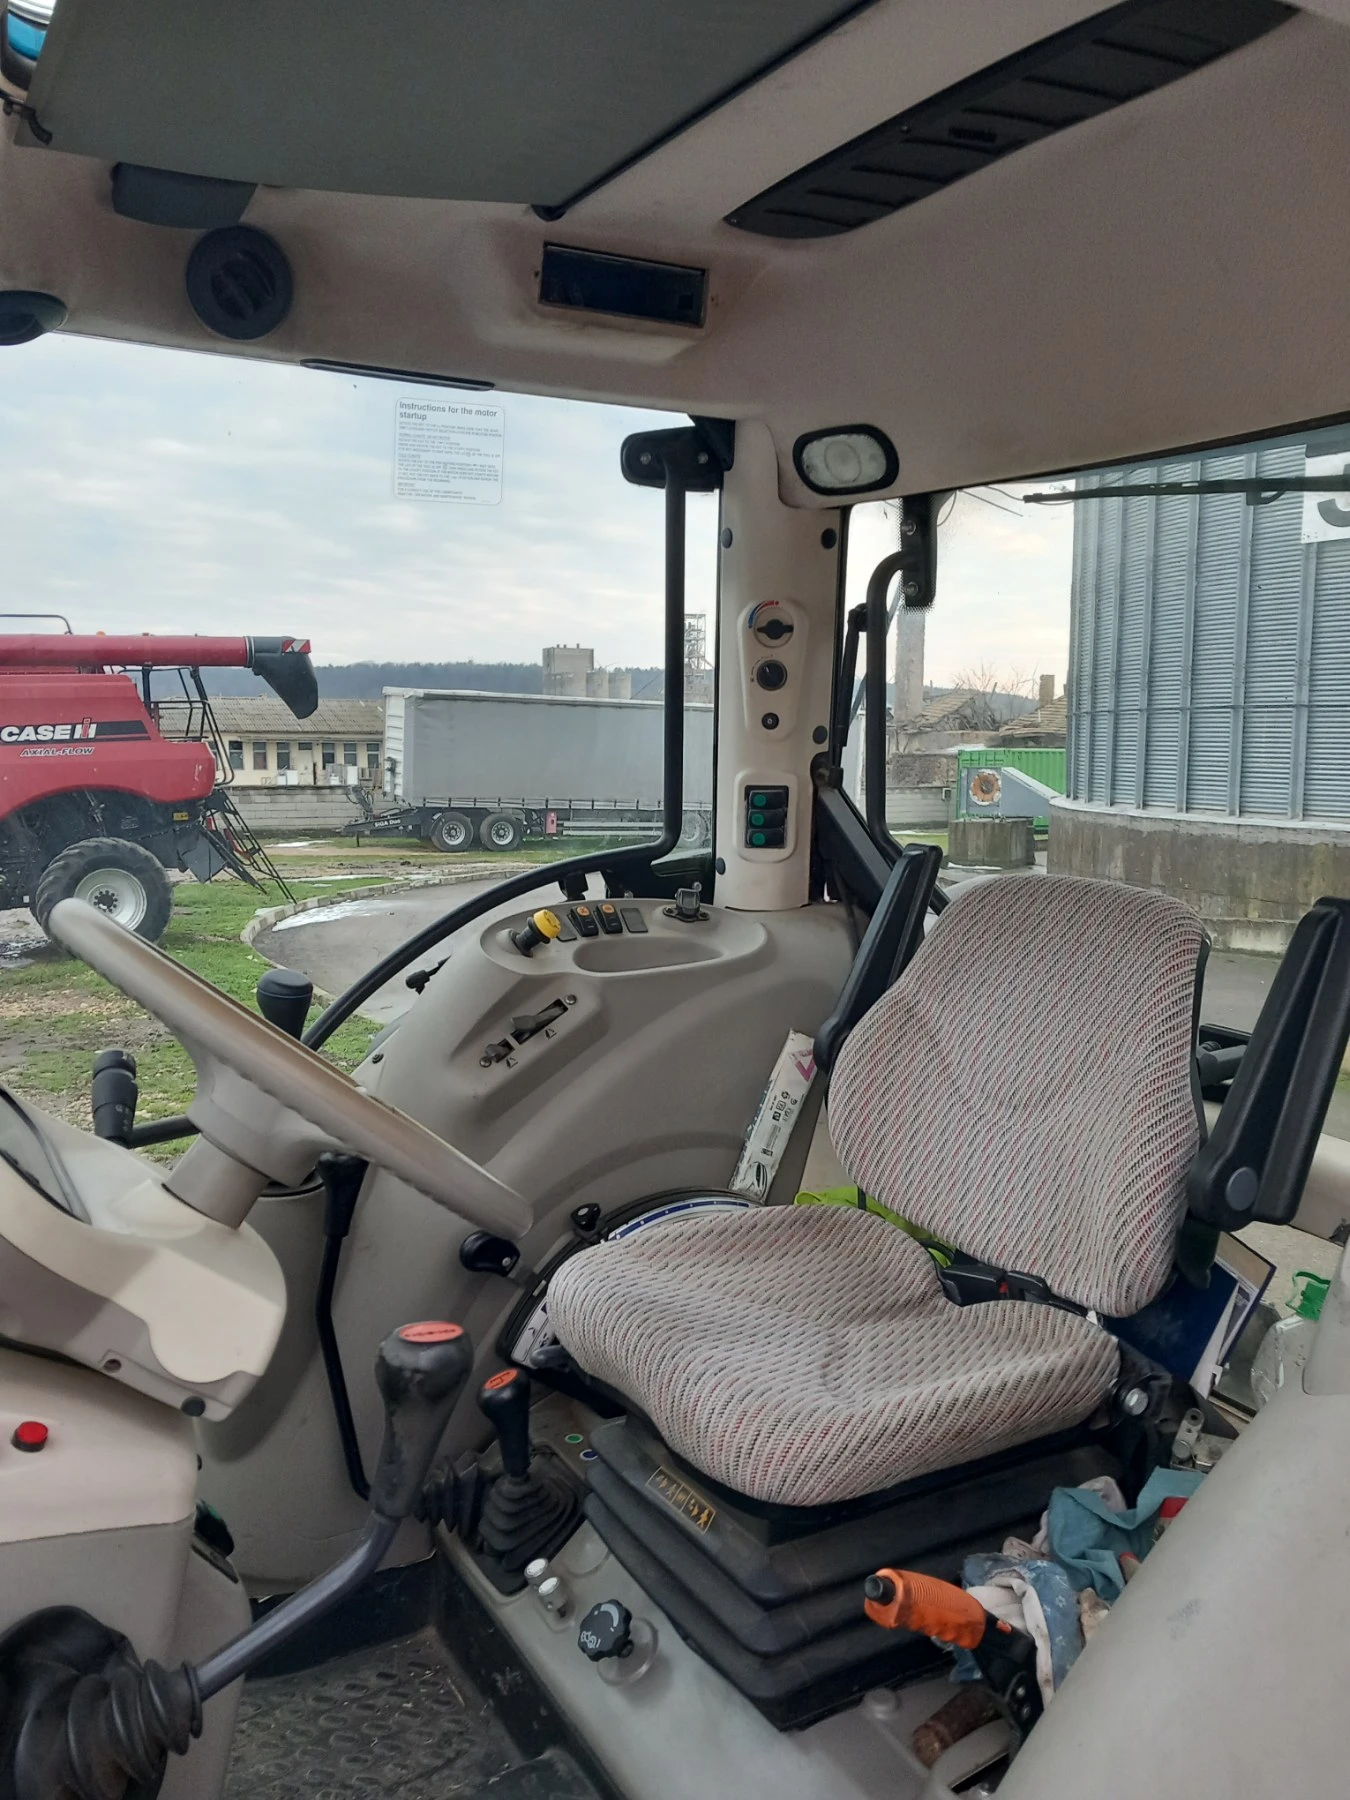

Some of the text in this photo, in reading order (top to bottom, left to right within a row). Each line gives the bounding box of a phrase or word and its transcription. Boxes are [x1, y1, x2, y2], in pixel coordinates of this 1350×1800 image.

[400, 401, 498, 417] Instructions for the motor
[400, 411, 427, 421] startup
[0, 724, 72, 742] CASE
[20, 746, 95, 757] AXIAL-FLOW
